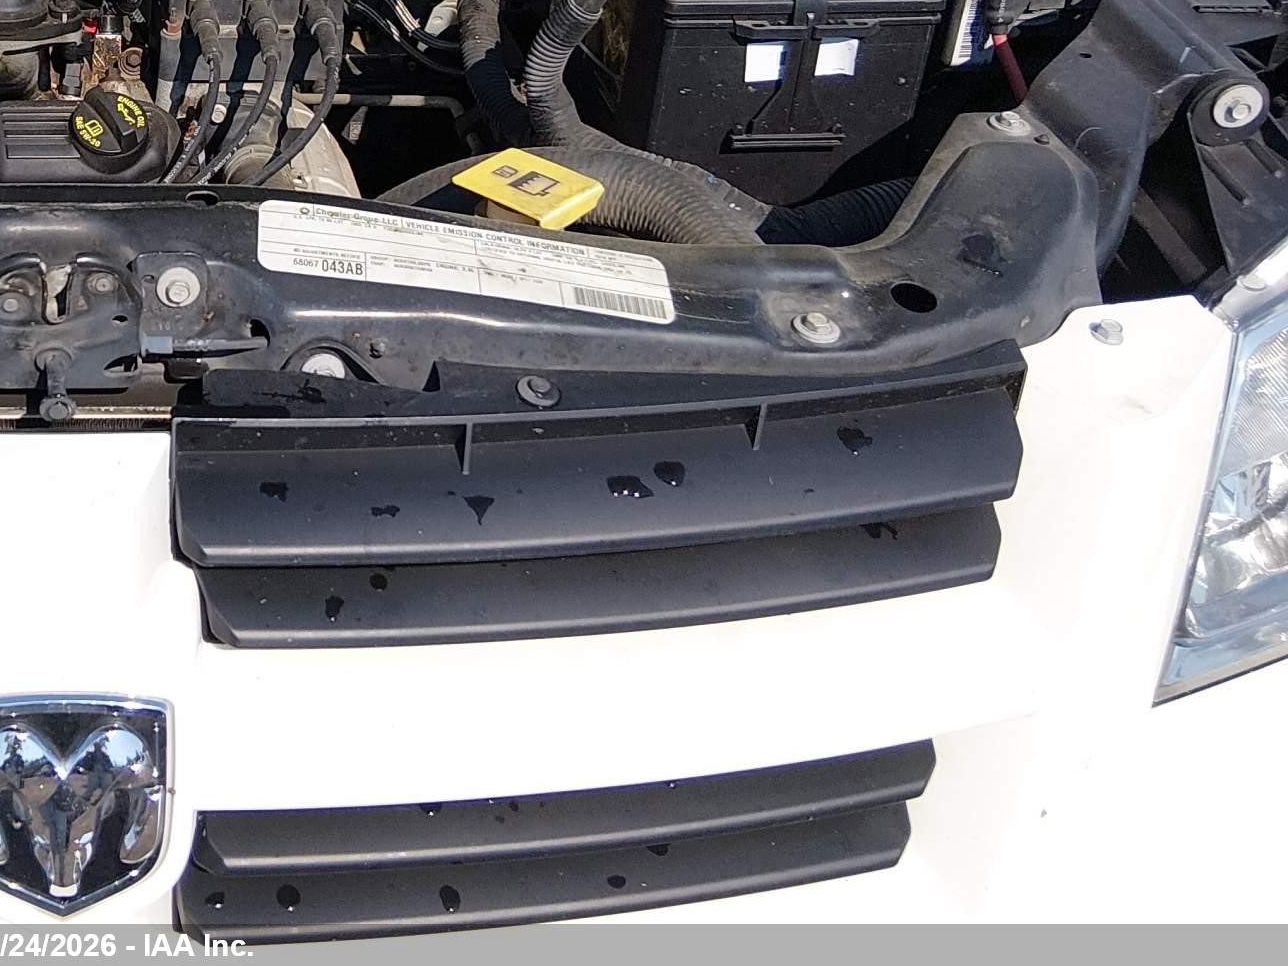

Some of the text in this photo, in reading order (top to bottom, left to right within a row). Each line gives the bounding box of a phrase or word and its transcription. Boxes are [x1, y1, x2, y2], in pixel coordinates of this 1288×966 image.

[116, 94, 146, 128] ENGINE OIL
[75, 115, 102, 149] SAE 5W-20
[353, 212, 380, 224] Group
[382, 217, 398, 226] LLC
[405, 221, 440, 233] VEHICLE
[442, 226, 483, 239] EMISSION
[485, 232, 524, 246] CONTROL
[527, 238, 586, 256] INFORMATION
[321, 259, 364, 276] 043AB
